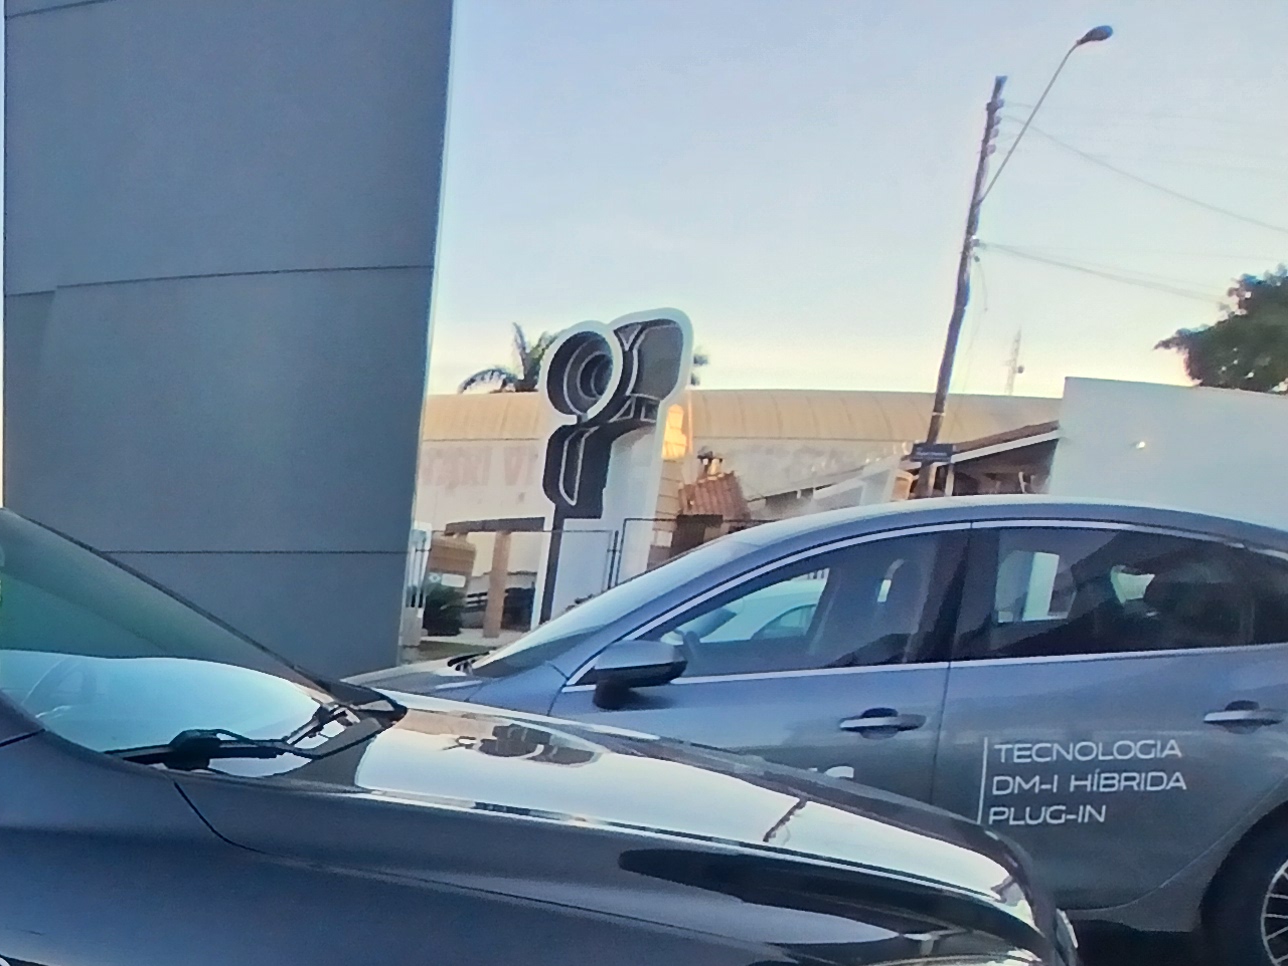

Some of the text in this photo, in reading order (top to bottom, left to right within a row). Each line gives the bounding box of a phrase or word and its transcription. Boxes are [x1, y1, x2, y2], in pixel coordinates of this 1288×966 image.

[994, 739, 1183, 763] TECNOLOGIA
[992, 768, 1187, 795] DM-I HÍBRIDA
[988, 804, 1107, 826] PLUG-IN
